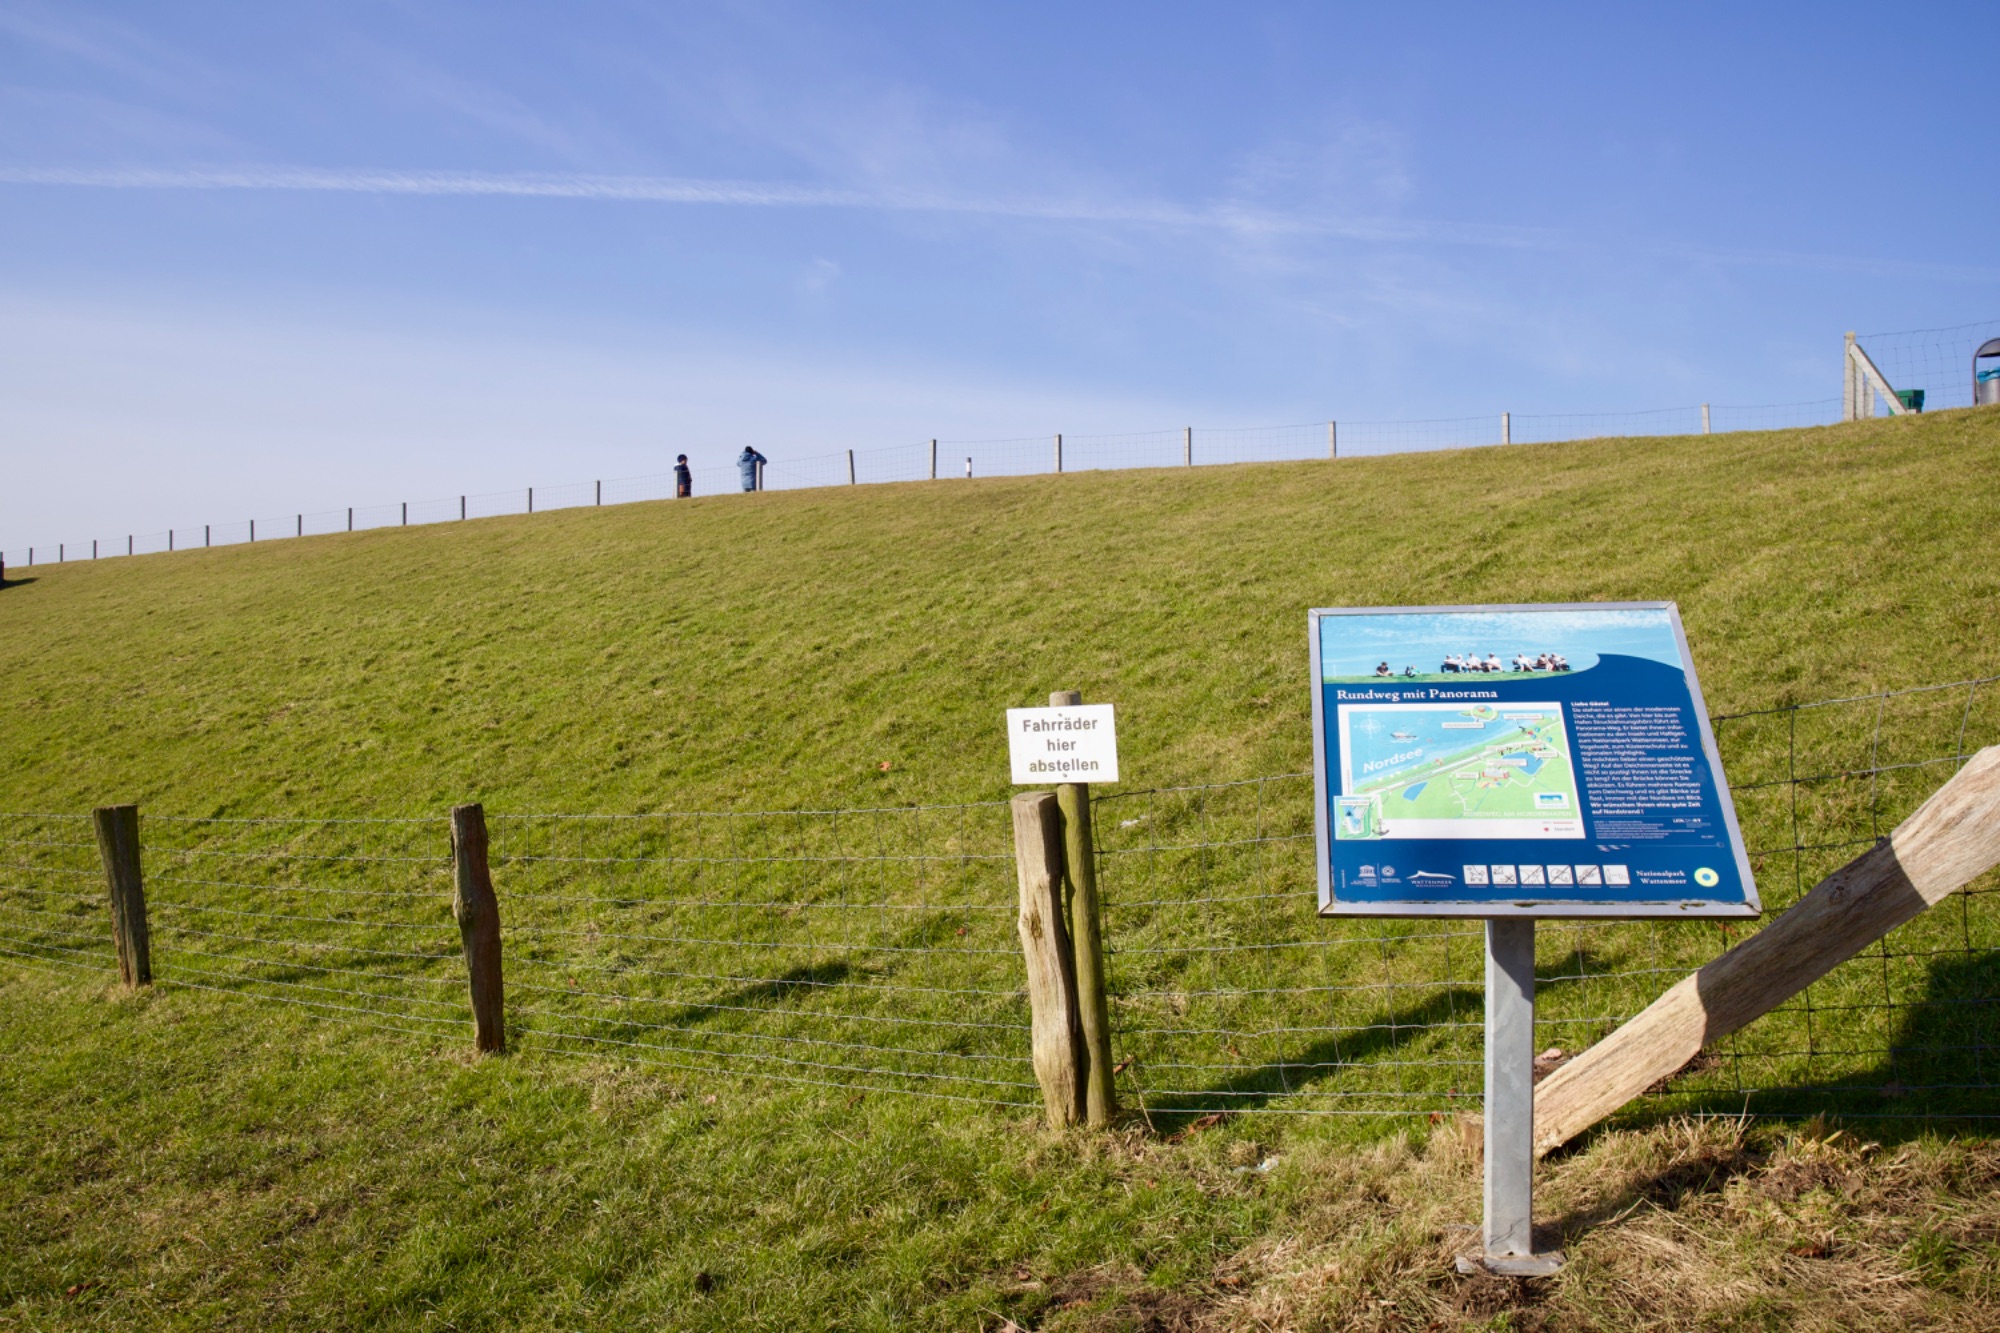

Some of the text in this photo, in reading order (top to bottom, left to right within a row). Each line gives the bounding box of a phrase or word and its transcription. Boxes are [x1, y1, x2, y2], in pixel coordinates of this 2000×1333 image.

[1337, 689, 1498, 701] Rundweg mit Panorama
[1023, 718, 1098, 732] Fahrräder
[1047, 738, 1076, 751] hier
[1029, 758, 1099, 772] abstellen
[1363, 748, 1423, 774] Nordsee
